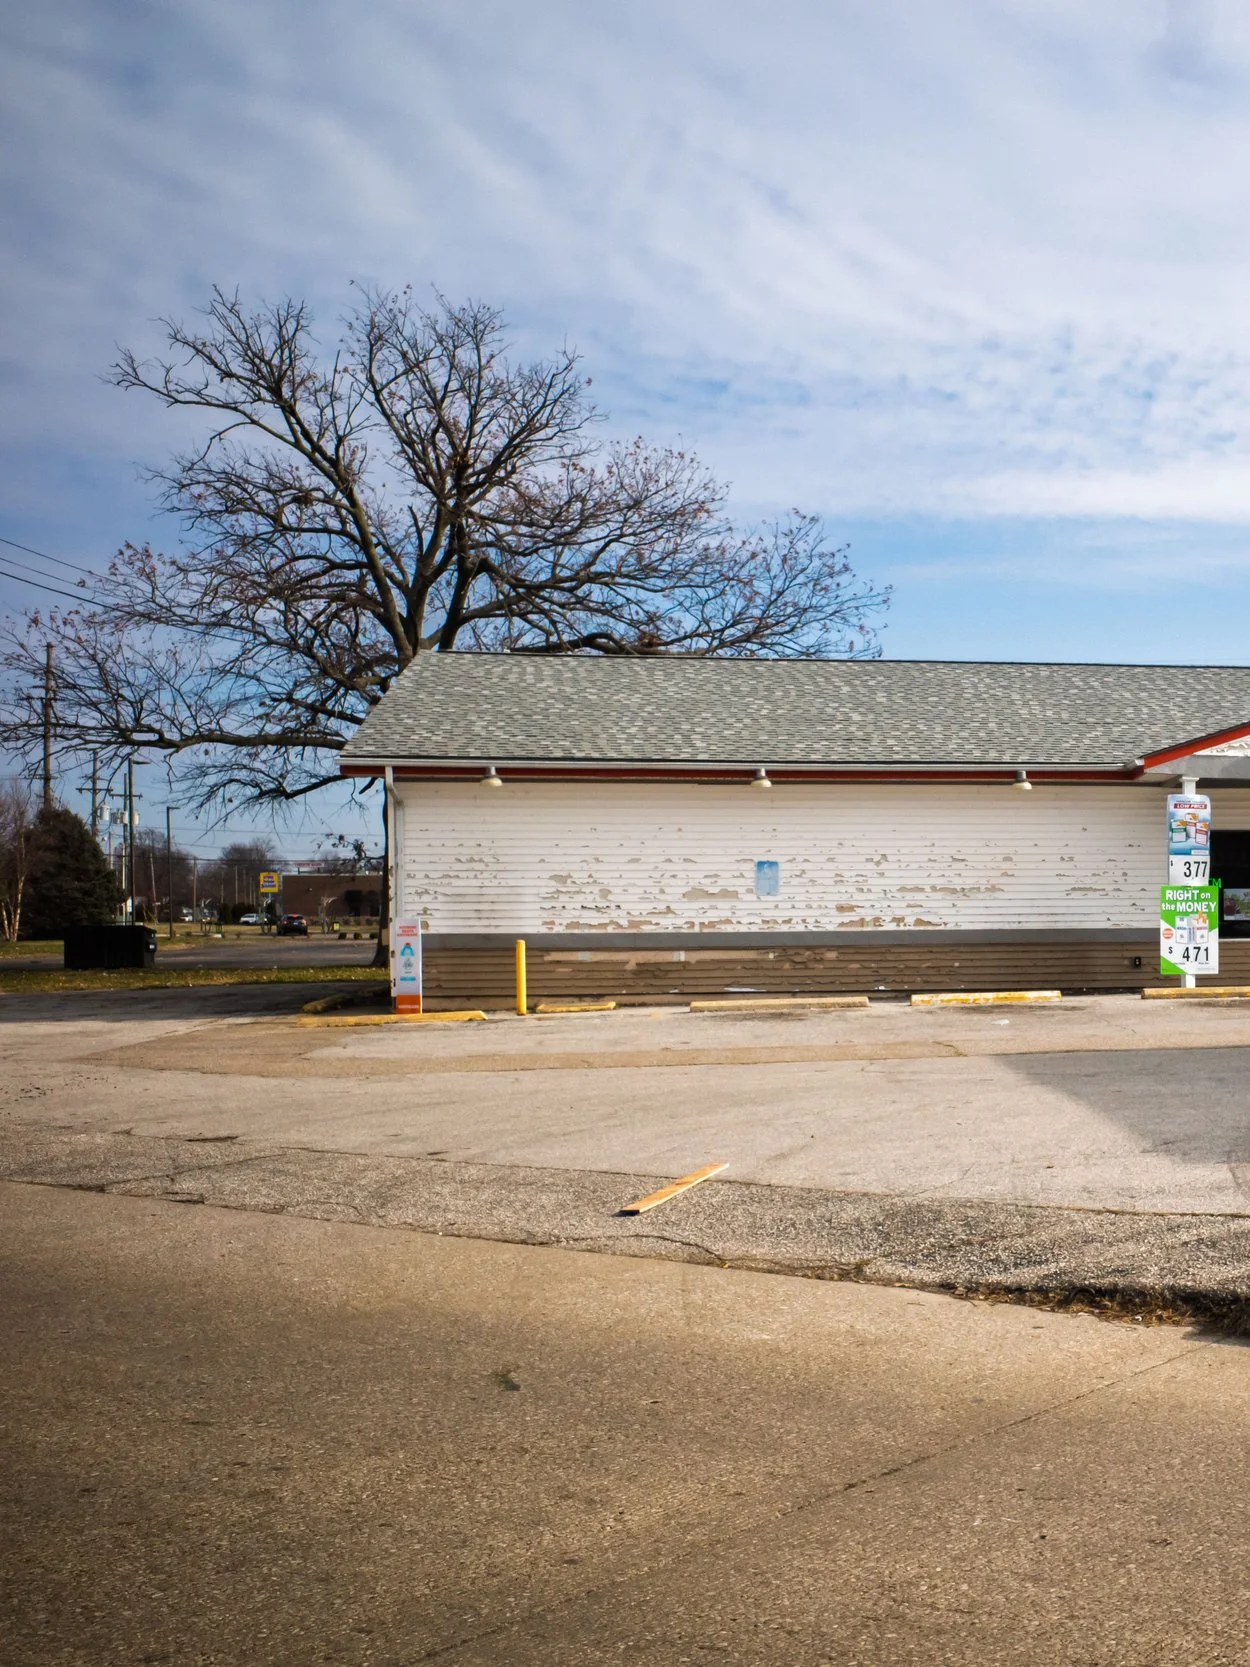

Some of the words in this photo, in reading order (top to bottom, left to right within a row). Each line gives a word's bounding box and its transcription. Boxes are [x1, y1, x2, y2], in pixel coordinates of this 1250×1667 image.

[1165, 889, 1199, 901] RIGHT
[1200, 892, 1211, 900] on
[1161, 902, 1176, 911] the
[1176, 901, 1217, 912] MONEY
[1168, 946, 1173, 955] $
